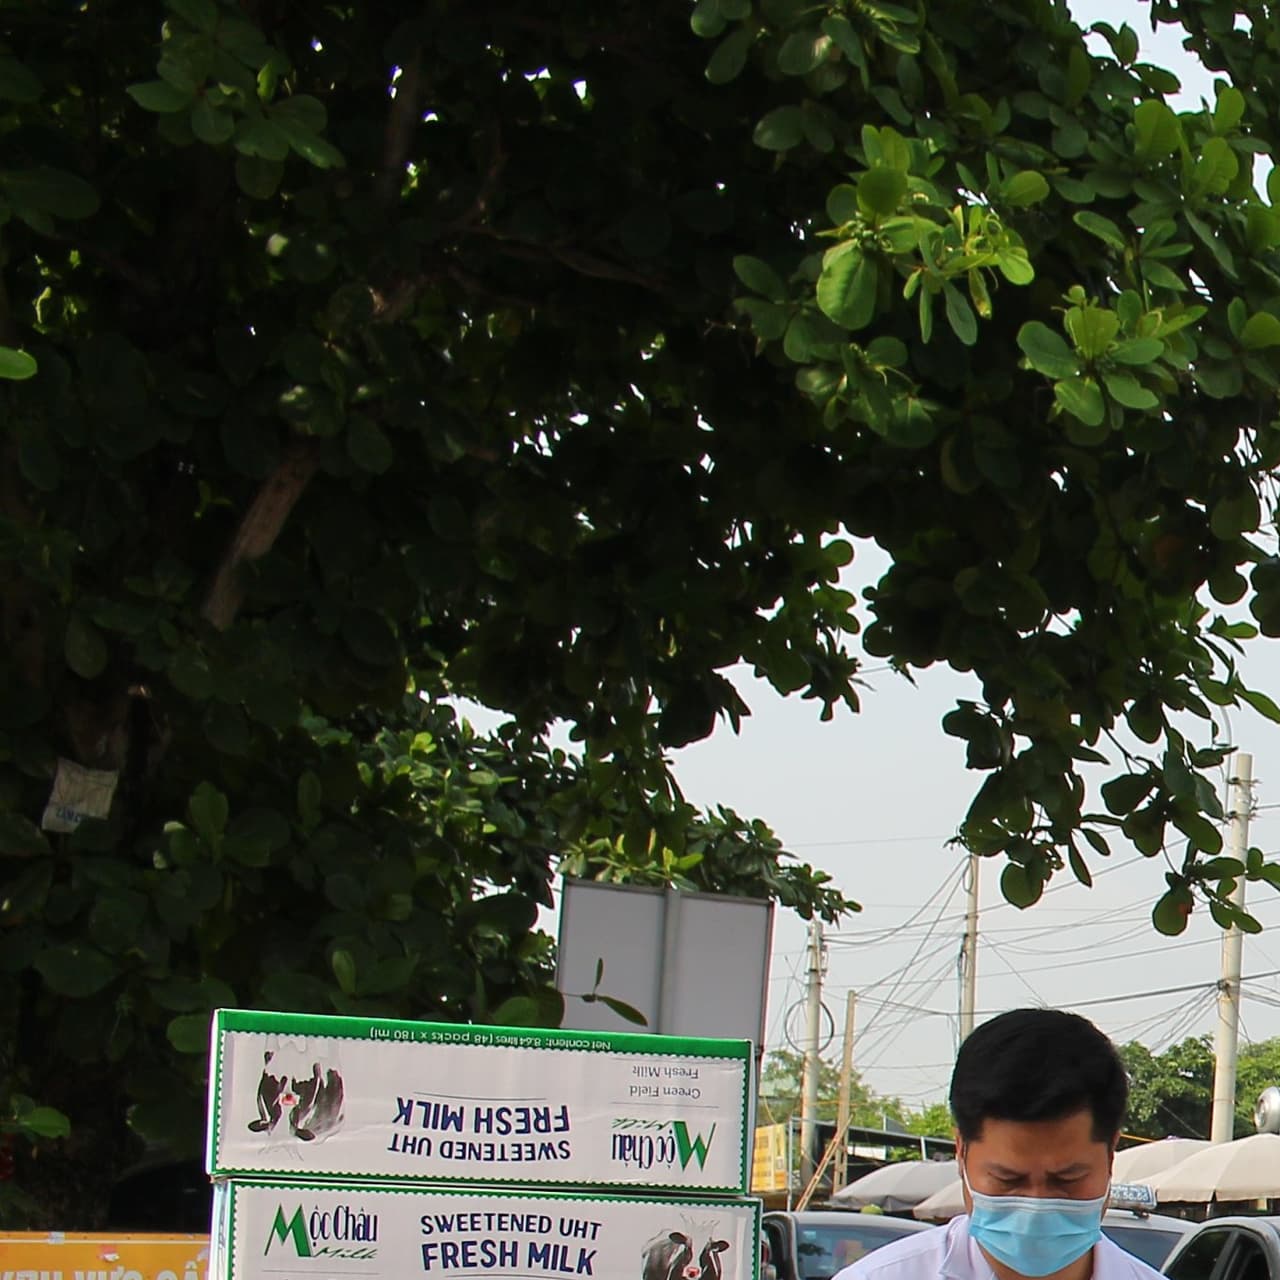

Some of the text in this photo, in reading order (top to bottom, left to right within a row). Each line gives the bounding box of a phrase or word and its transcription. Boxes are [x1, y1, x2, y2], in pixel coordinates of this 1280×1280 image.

[632, 1066, 699, 1080] Fresh Milk
[630, 1084, 701, 1099] Green Field
[392, 1097, 571, 1134] FRESH MILK
[388, 1133, 571, 1162] SWEETENED UHT
[421, 1213, 602, 1241] SWEETENED UHT
[421, 1239, 598, 1276] FRESH MILK
